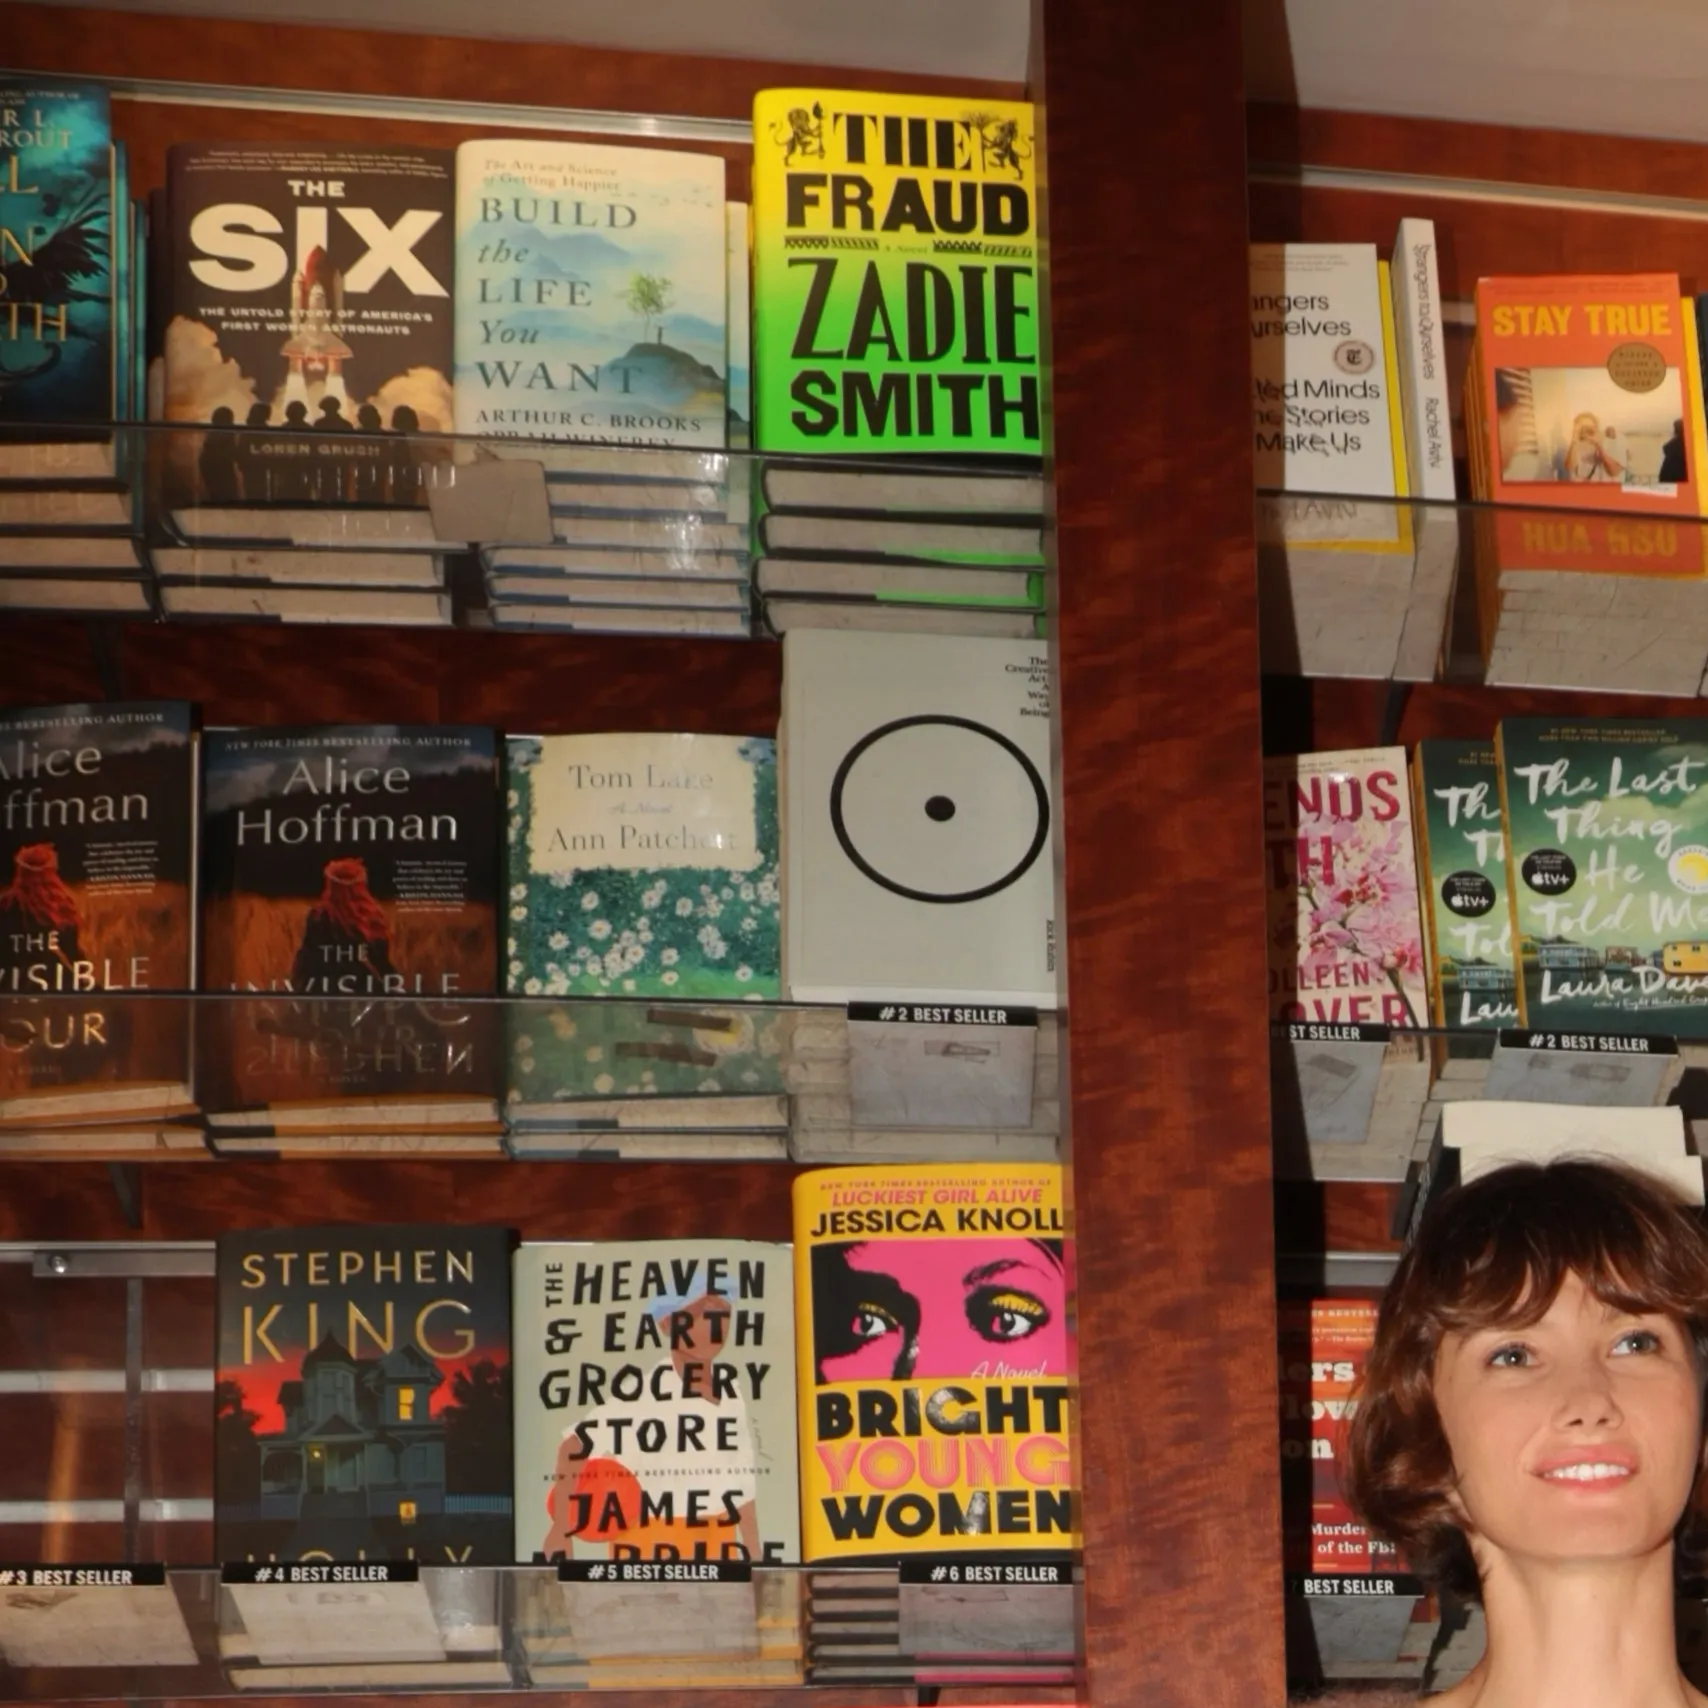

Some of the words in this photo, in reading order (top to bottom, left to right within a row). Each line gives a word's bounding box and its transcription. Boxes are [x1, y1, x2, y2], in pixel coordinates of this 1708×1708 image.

[288, 180, 344, 197] THE
[785, 173, 1030, 236] FRAUD
[478, 197, 638, 230] BUILD
[188, 203, 449, 298] SIX
[478, 242, 529, 264] the
[478, 278, 592, 307] LIFE
[788, 258, 1037, 365] ZADIE
[480, 321, 539, 346] You
[1493, 304, 1570, 337] STAY
[1585, 305, 1672, 336] TRUE
[477, 408, 575, 428] ARTHUR
[609, 413, 702, 432] BROOKS
[790, 370, 1040, 440] SMITH
[282, 758, 411, 794] Alice
[1513, 763, 1598, 805] The
[1609, 757, 1706, 795] Last
[236, 805, 459, 846] Hoffman
[1545, 801, 1682, 856] Thing
[1584, 847, 1644, 891] He
[1529, 898, 1637, 936] Told
[913, 1006, 949, 1023] BEST
[954, 1007, 1006, 1025] SELLER
[833, 1188, 926, 1207] LUCKIEST
[932, 1188, 980, 1206] GIRL
[985, 1187, 1043, 1204] ALIVE
[811, 1209, 945, 1237] JESSICA
[957, 1207, 1064, 1232] KNOLL
[241, 1250, 474, 1288] STEPHEN
[572, 1259, 765, 1305] HEAVEN
[242, 1299, 477, 1364] KING
[603, 1310, 764, 1353] EARTH
[539, 1363, 771, 1410] GROCERY
[568, 1417, 738, 1460] STORE
[564, 1489, 744, 1537] JAMES
